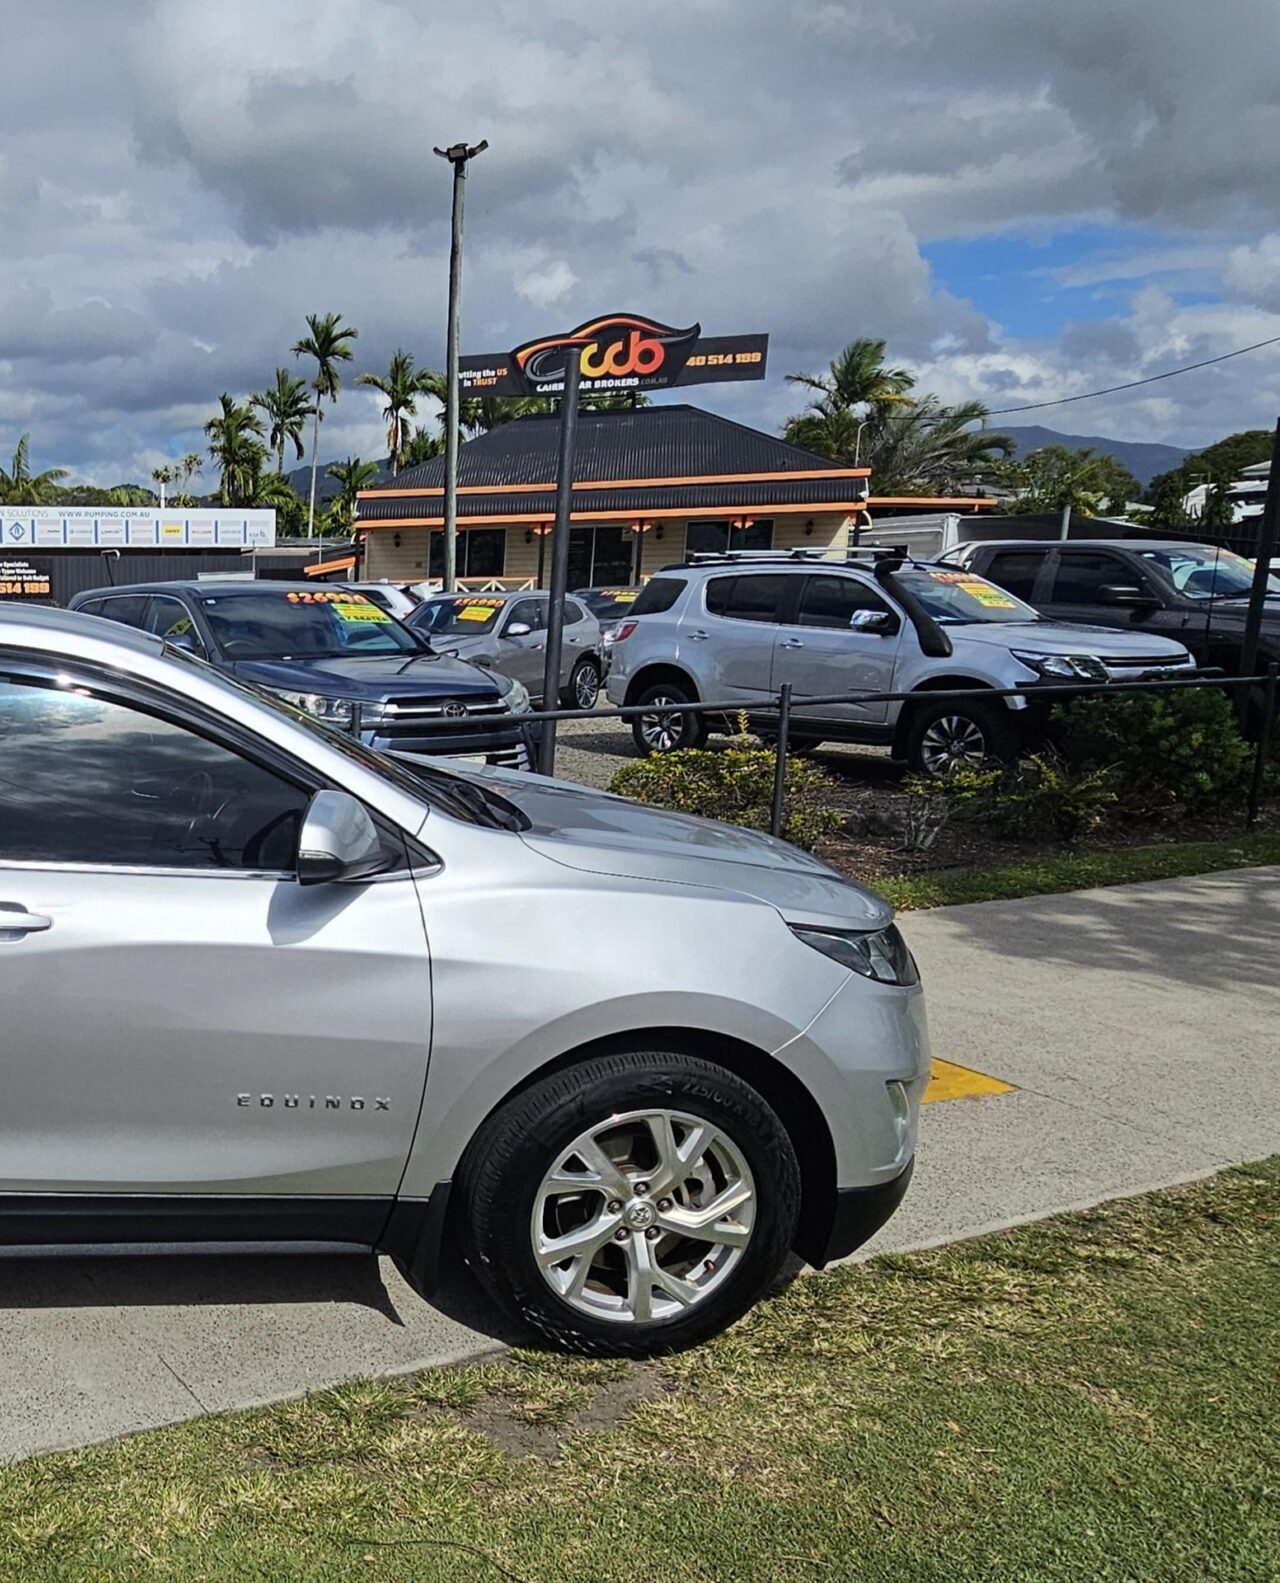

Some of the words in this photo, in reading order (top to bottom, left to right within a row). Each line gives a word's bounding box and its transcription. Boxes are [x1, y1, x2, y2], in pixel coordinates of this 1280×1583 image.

[707, 354, 733, 365] 514
[458, 370, 482, 379] utting
[536, 382, 565, 392] CAIRN
[578, 381, 592, 390] AR
[23, 582, 50, 594] 199
[237, 1093, 391, 1112] EQUINOX
